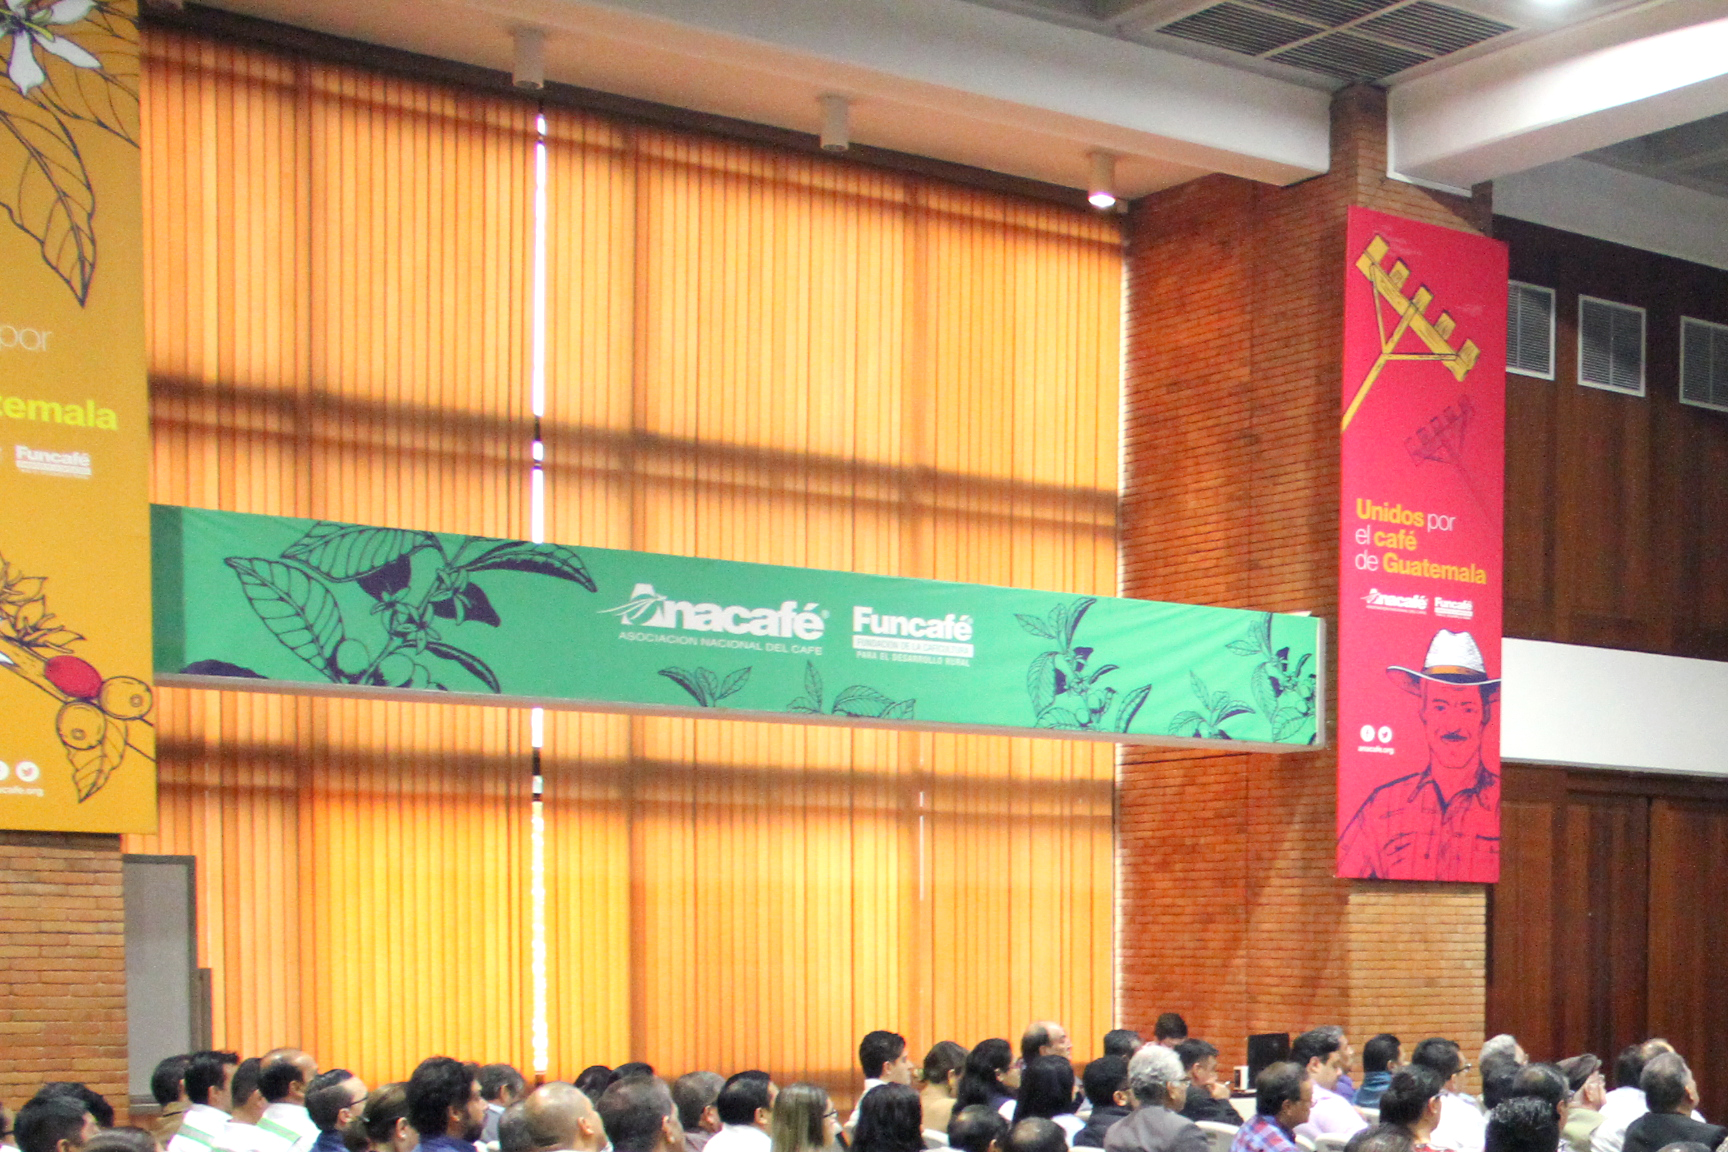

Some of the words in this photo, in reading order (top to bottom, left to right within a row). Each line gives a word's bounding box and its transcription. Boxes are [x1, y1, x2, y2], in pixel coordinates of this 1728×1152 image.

[15, 444, 91, 466] Funcafé
[1355, 498, 1424, 527] Unidos
[1427, 513, 1456, 533] por
[1355, 525, 1371, 545] el
[1373, 530, 1417, 551] café
[1355, 549, 1378, 572] de
[1383, 552, 1487, 585] Guatemala
[853, 606, 973, 641] Funcafé
[618, 631, 698, 646] ASOCIACION
[700, 638, 762, 651] NACIONAL
[765, 642, 789, 653] DEL
